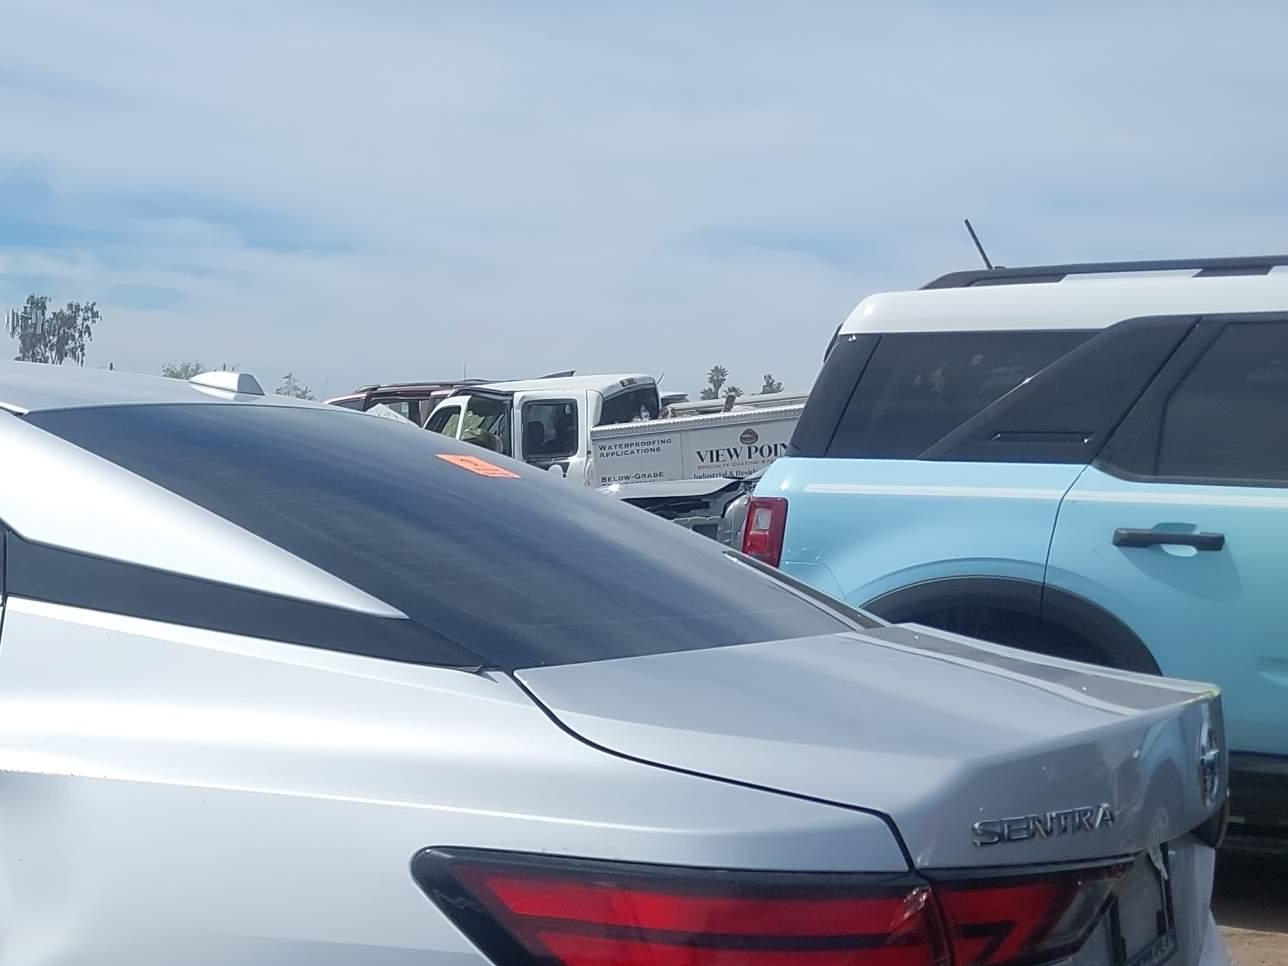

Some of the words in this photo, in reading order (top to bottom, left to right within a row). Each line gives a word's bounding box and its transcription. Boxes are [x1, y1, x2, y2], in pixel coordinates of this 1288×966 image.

[598, 438, 672, 451] WATERPROOFING
[599, 446, 661, 458] APPLICATIONS
[696, 447, 743, 463] VIEW
[600, 471, 665, 483] BELOW-GRADE
[971, 802, 1115, 847] SENTRA
